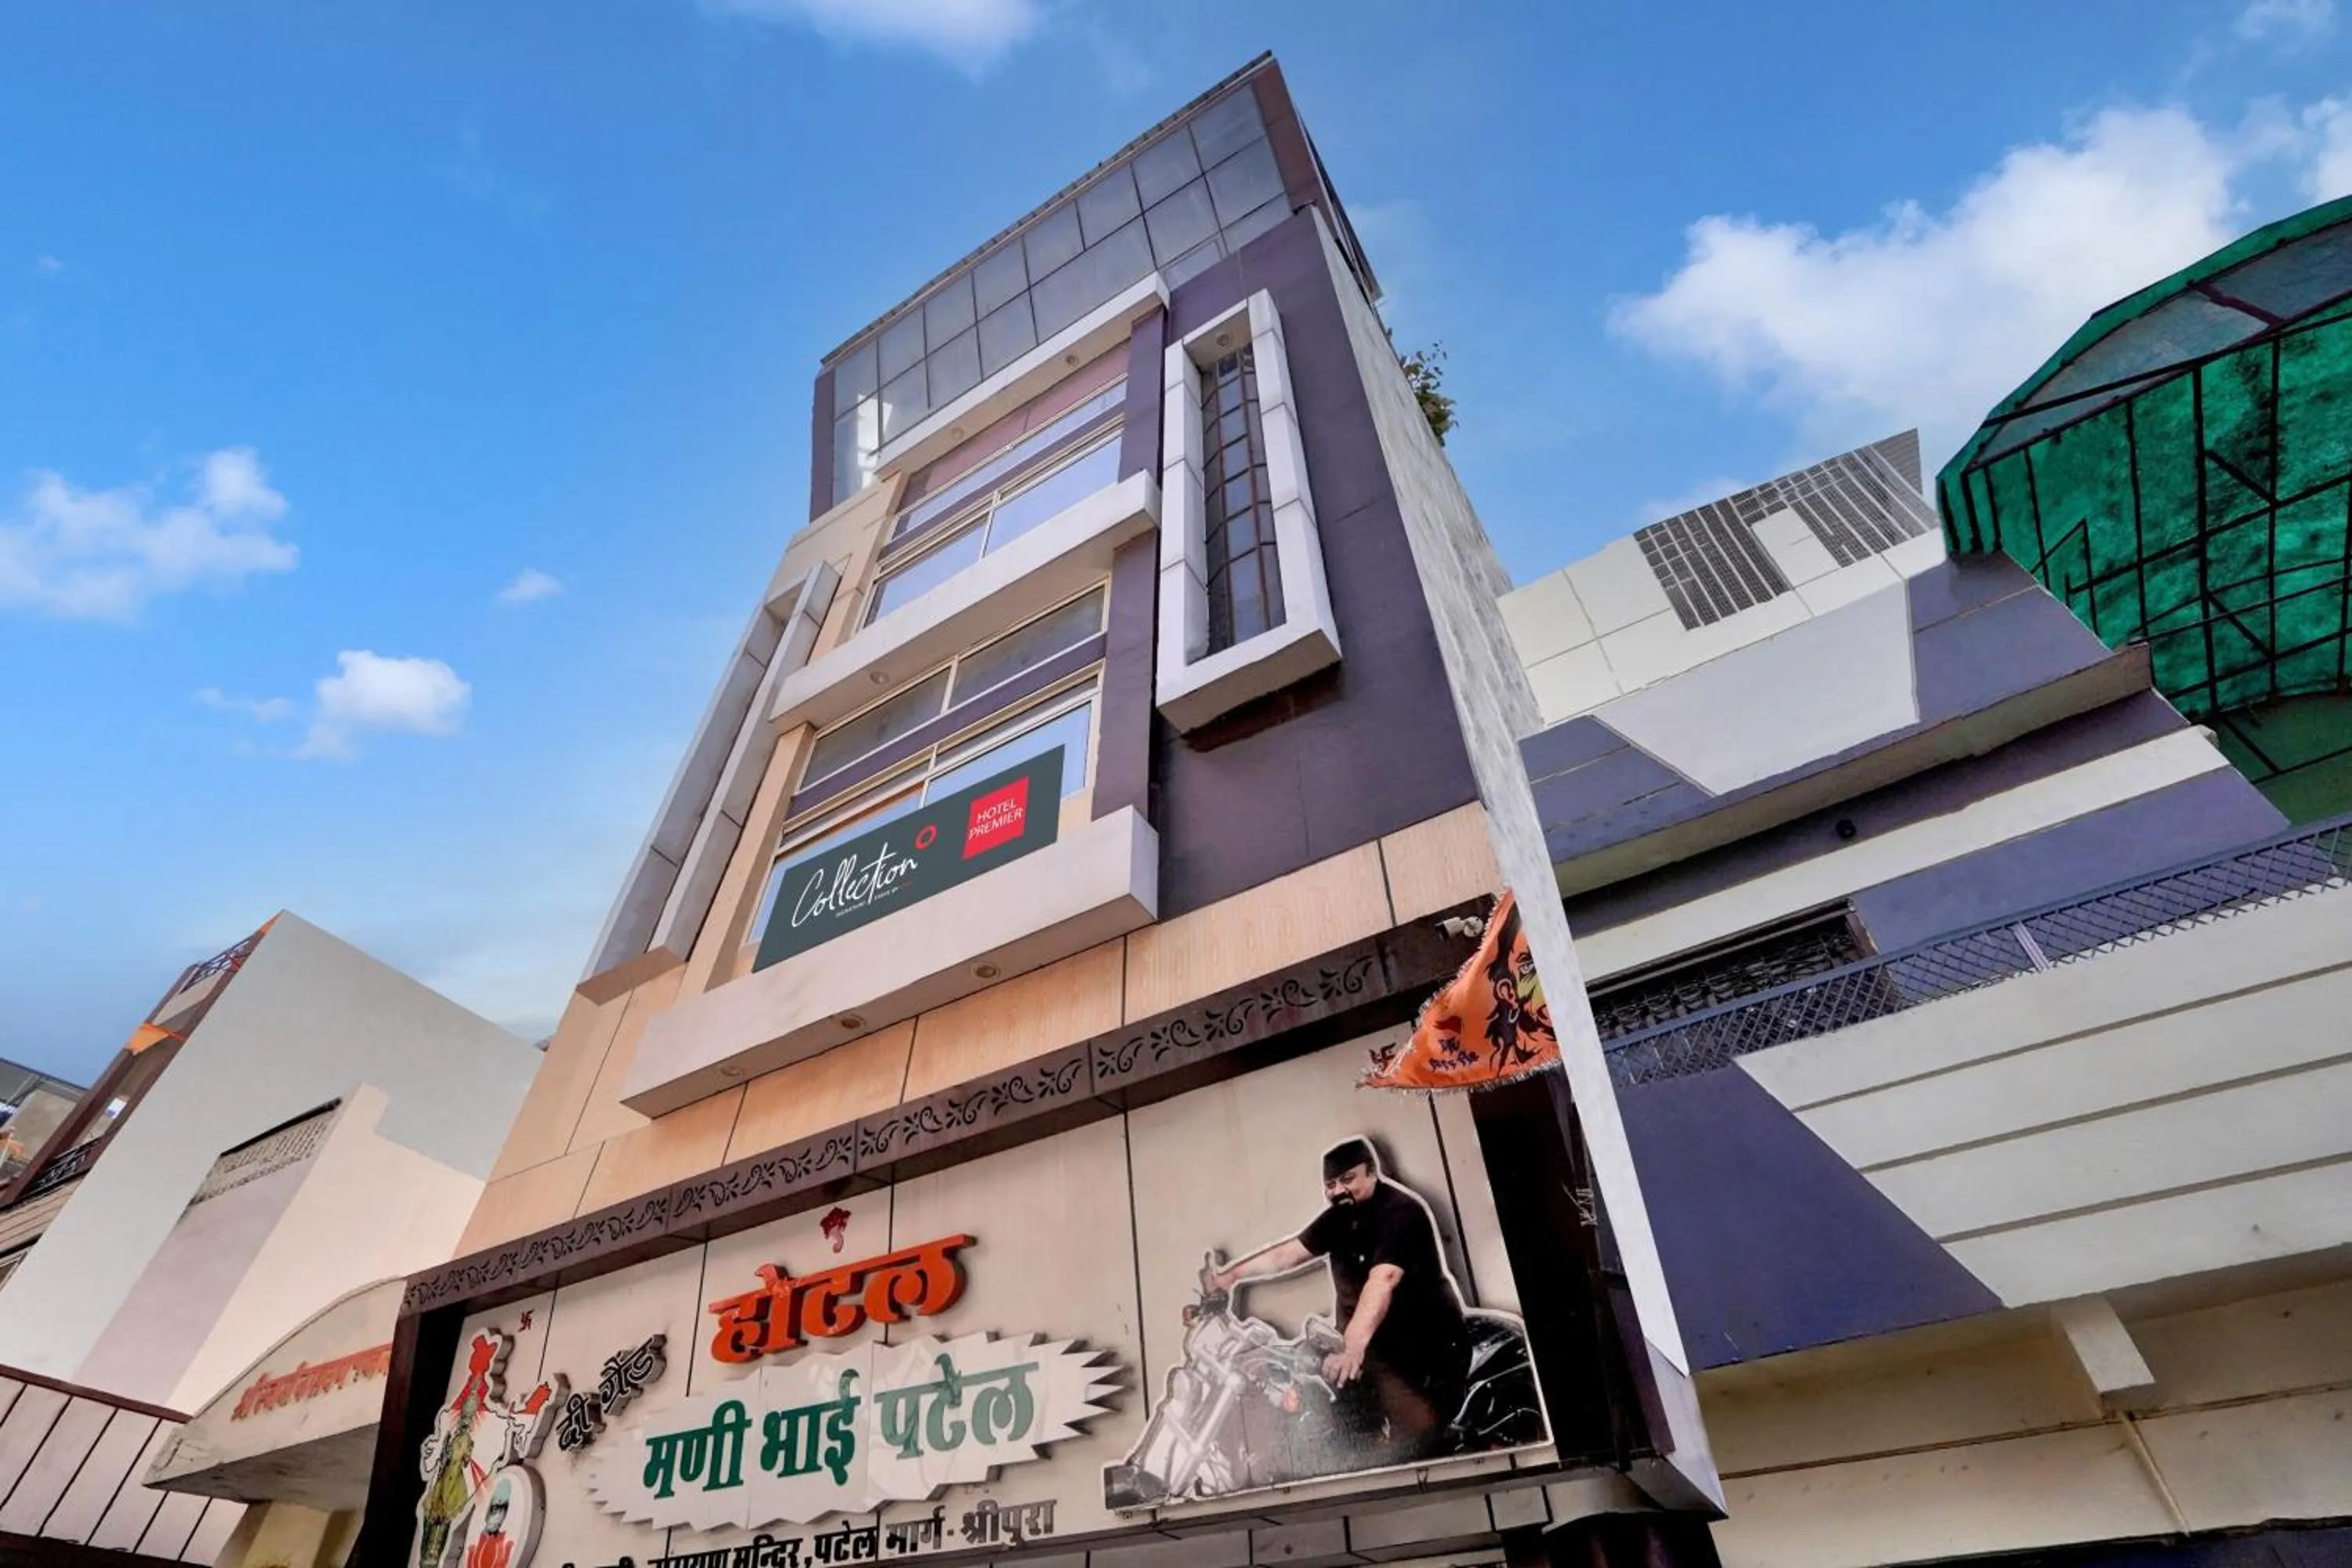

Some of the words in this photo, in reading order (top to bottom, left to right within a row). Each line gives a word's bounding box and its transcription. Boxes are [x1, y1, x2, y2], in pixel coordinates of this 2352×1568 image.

[967, 807, 1024, 841] PREMIER
[977, 797, 1018, 824] HOTEL
[791, 842, 918, 927] Collection
[709, 1233, 978, 1364] होटल
[642, 1399, 753, 1500] मणी
[760, 1368, 862, 1487] भाई
[873, 1352, 1040, 1461] पटेल
[814, 1519, 877, 1564] पटेल
